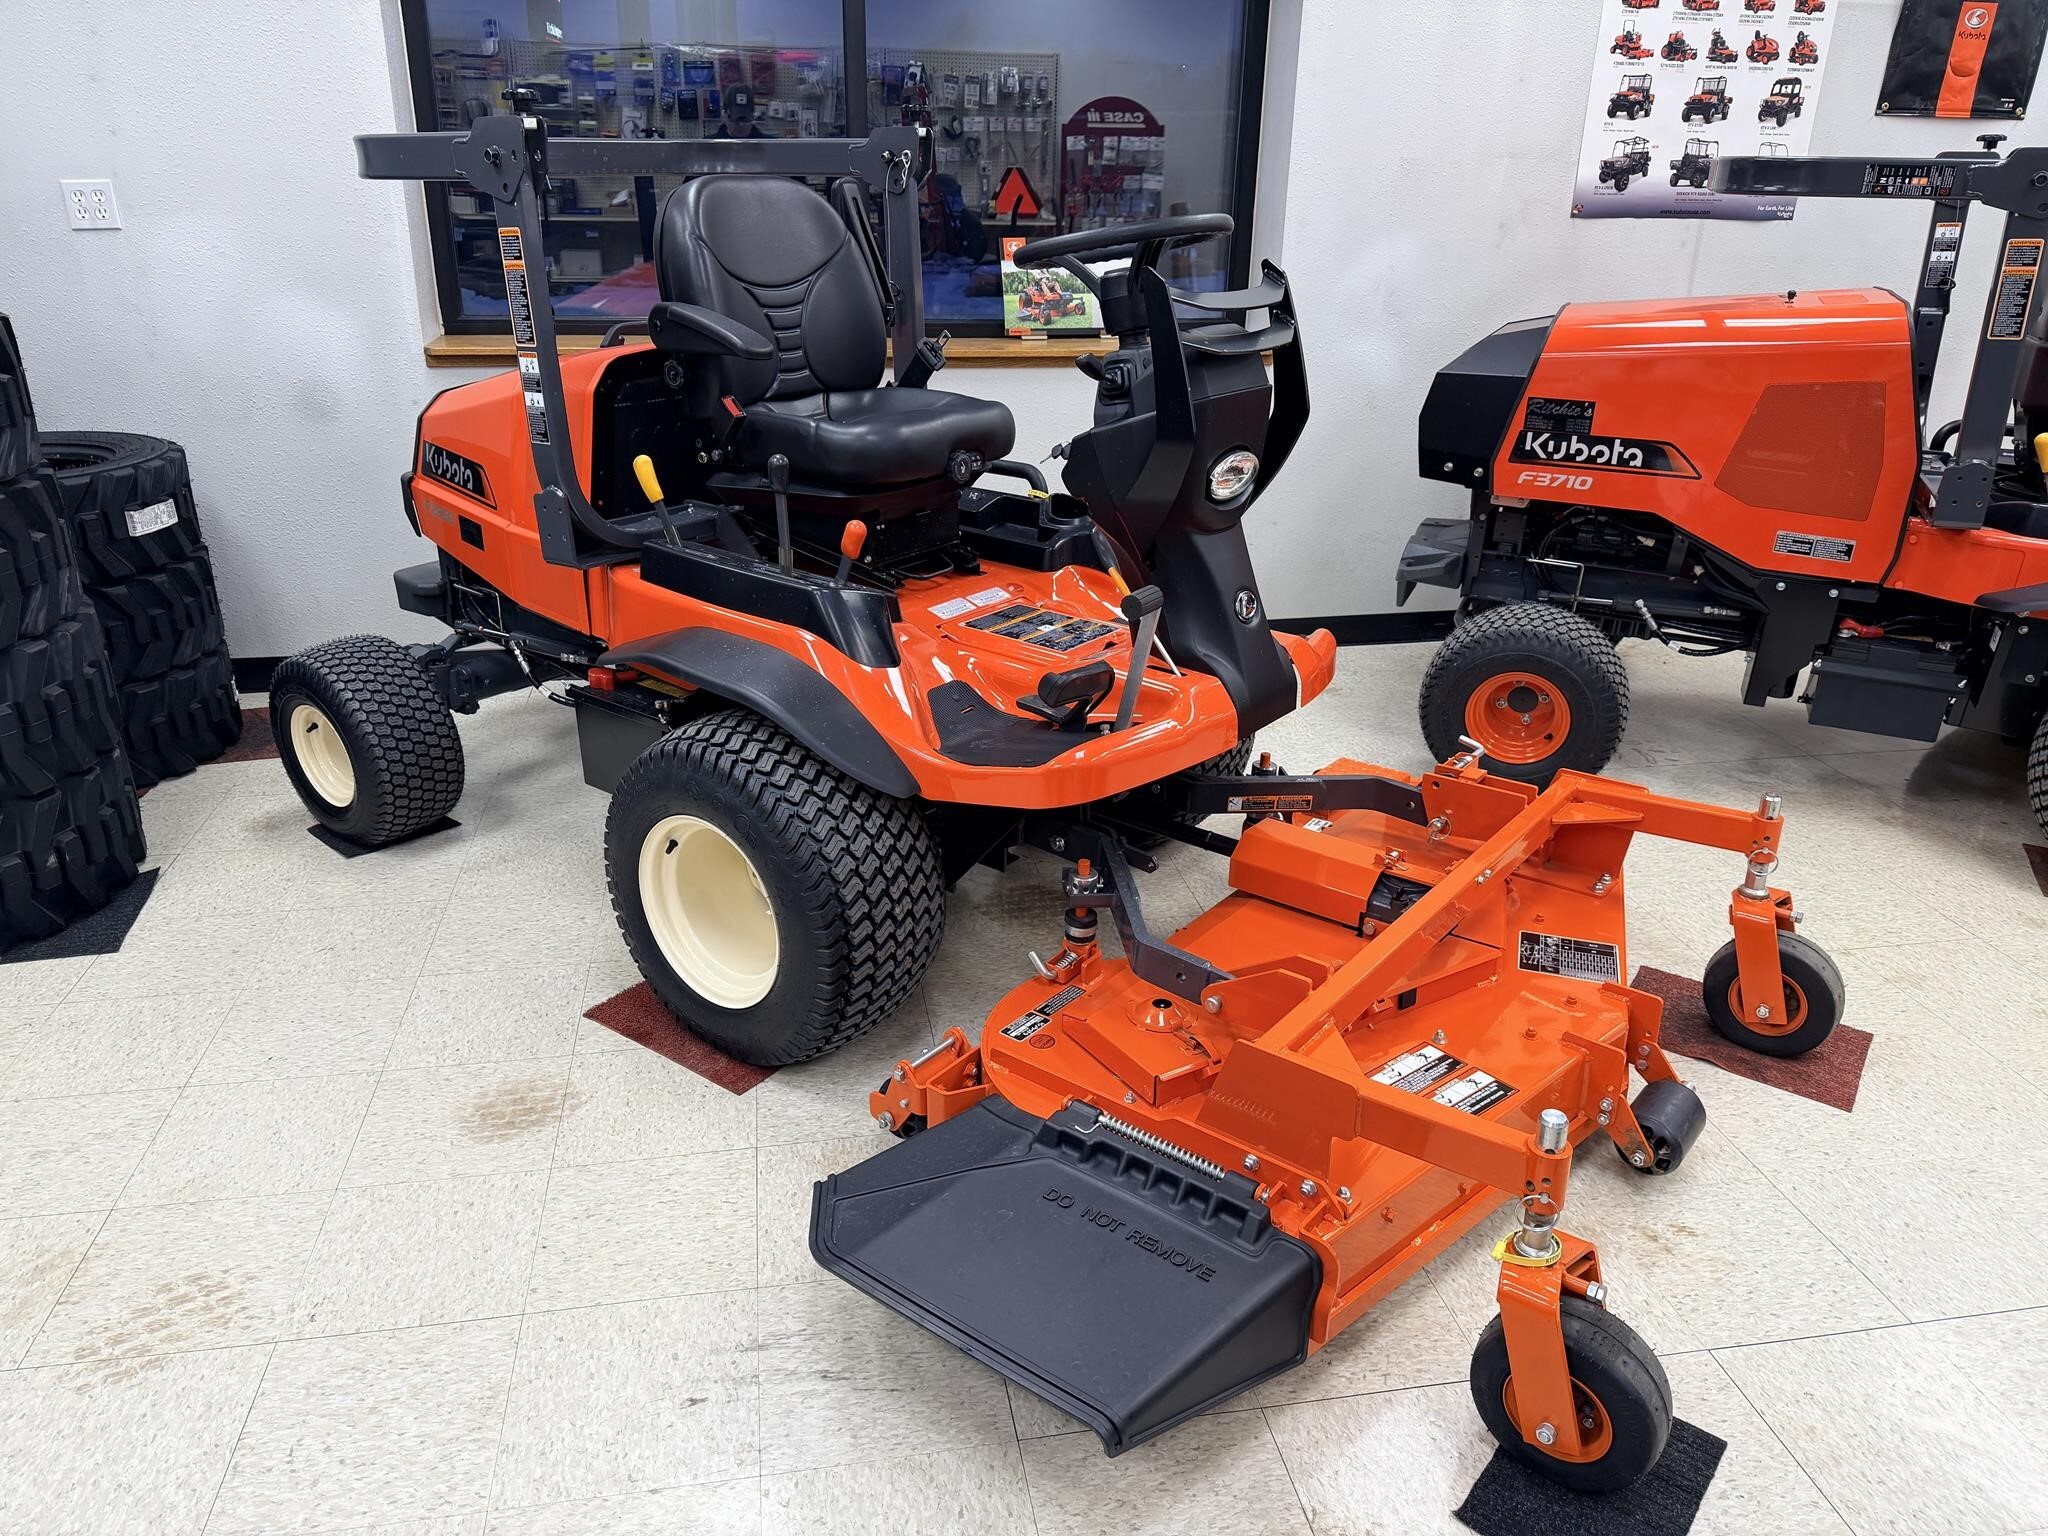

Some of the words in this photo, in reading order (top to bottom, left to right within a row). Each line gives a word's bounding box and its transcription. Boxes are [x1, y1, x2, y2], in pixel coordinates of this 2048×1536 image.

[1958, 30, 1986, 41] Kubota
[1528, 397, 1593, 418] Ritchie's
[1524, 431, 1643, 467] Kubota
[425, 442, 474, 490] Kubota
[1516, 471, 1595, 490] F3710
[1042, 1187, 1076, 1208] DO
[1080, 1204, 1126, 1233] NOT
[1125, 1227, 1217, 1283] REMOVE
